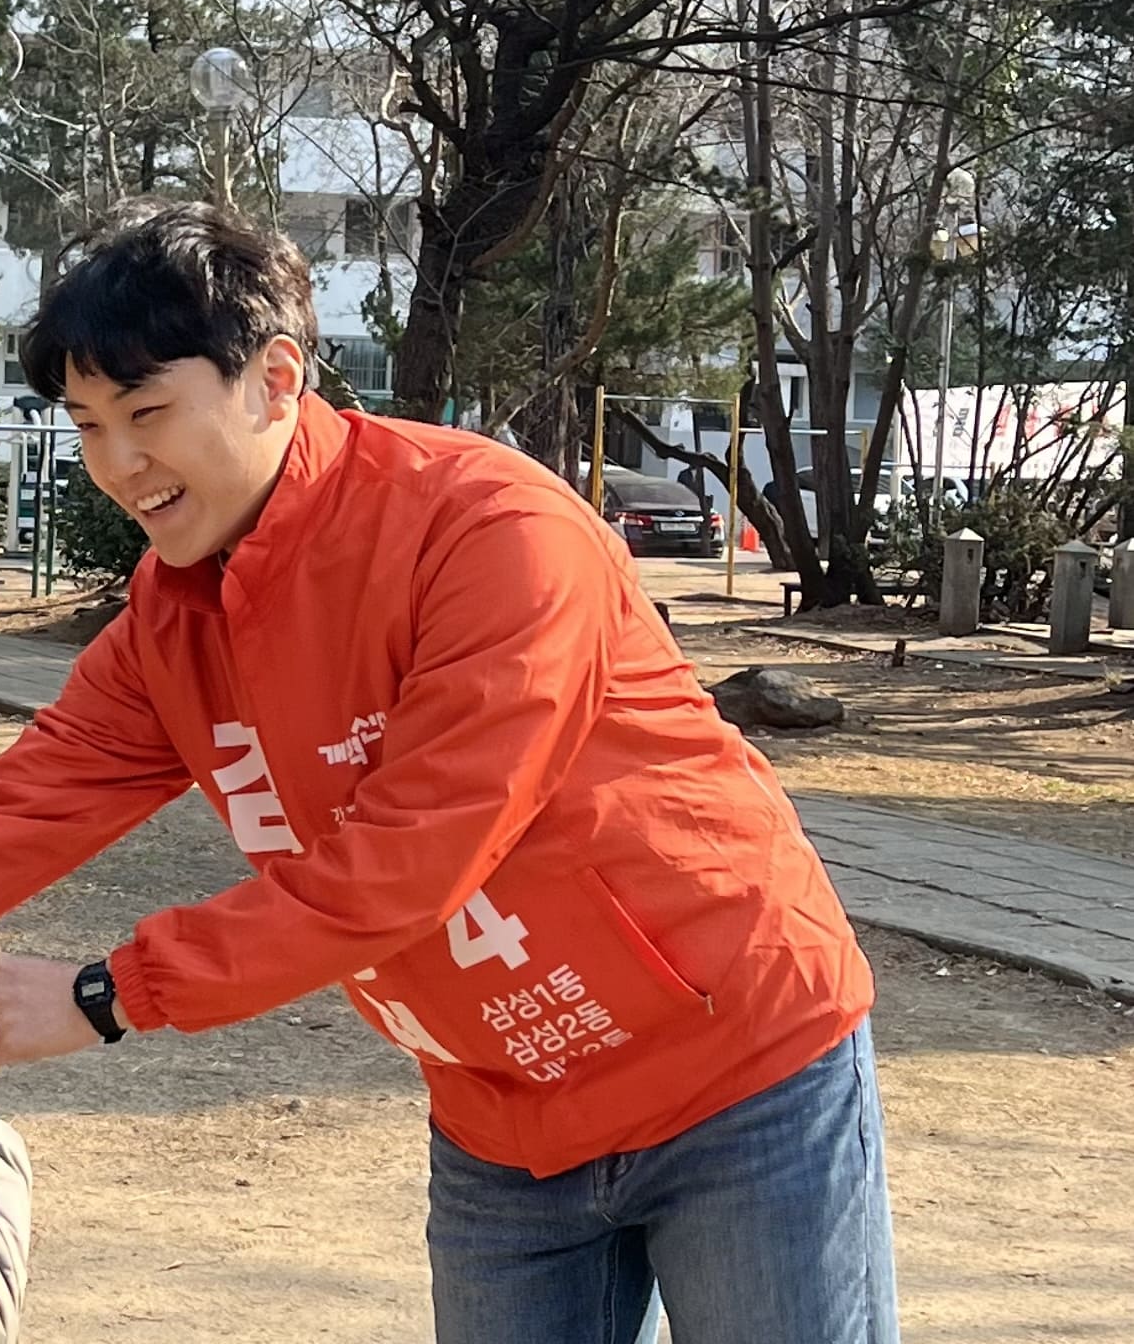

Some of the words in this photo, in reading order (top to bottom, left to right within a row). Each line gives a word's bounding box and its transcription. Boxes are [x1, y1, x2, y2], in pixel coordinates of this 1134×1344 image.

[317, 711, 387, 765] 개혁신
[446, 887, 530, 970] 4
[480, 963, 586, 1032] 삼성1동
[505, 999, 612, 1066] 삼성2동
